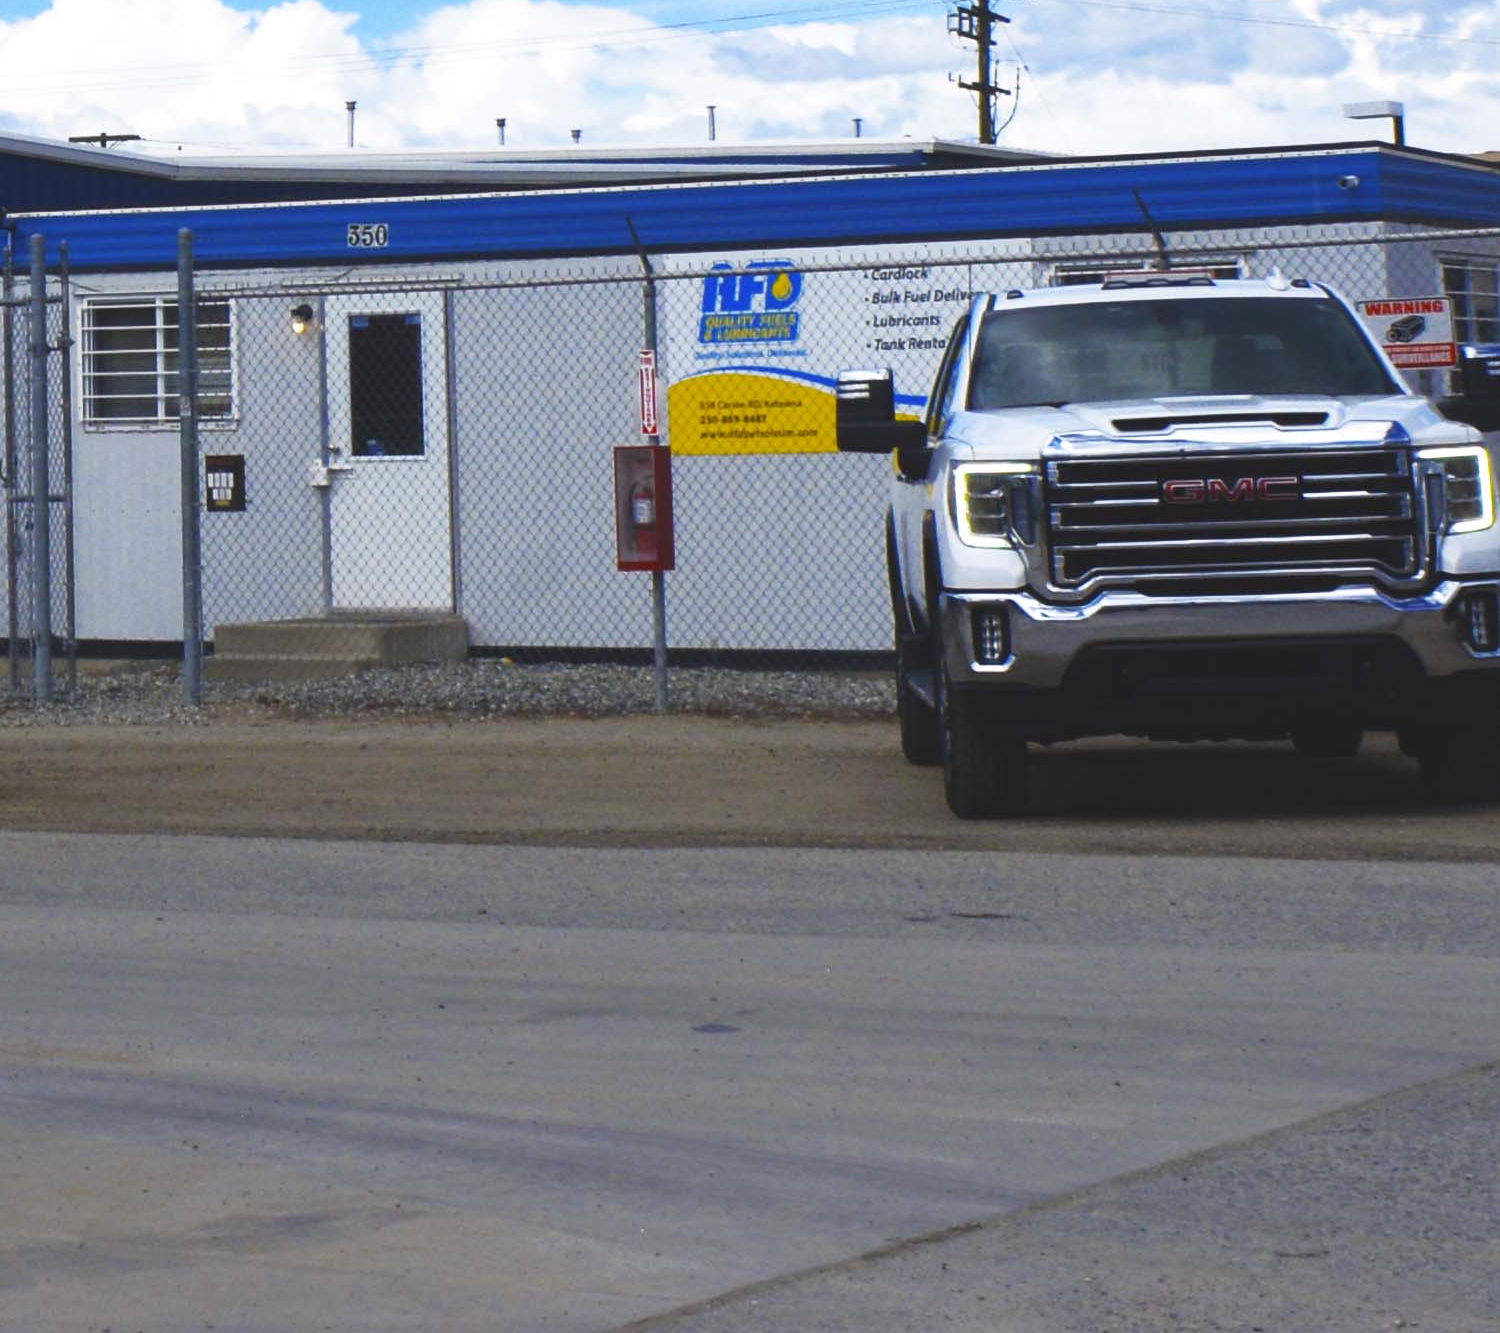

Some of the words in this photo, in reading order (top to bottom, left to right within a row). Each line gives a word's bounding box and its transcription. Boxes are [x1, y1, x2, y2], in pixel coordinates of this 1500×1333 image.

[348, 224, 388, 247] 350
[702, 258, 803, 313] AFD
[871, 268, 928, 281] Cardlock
[872, 293, 900, 304] Bulk
[904, 291, 930, 303] Fuel
[1364, 300, 1444, 316] WARNING
[706, 316, 753, 329] QUALITY
[759, 313, 796, 326] FUELS
[873, 315, 941, 327] Lubricants
[717, 327, 790, 340] LUBRICANTS
[874, 338, 905, 351] Tank
[1162, 475, 1298, 503] GMC
